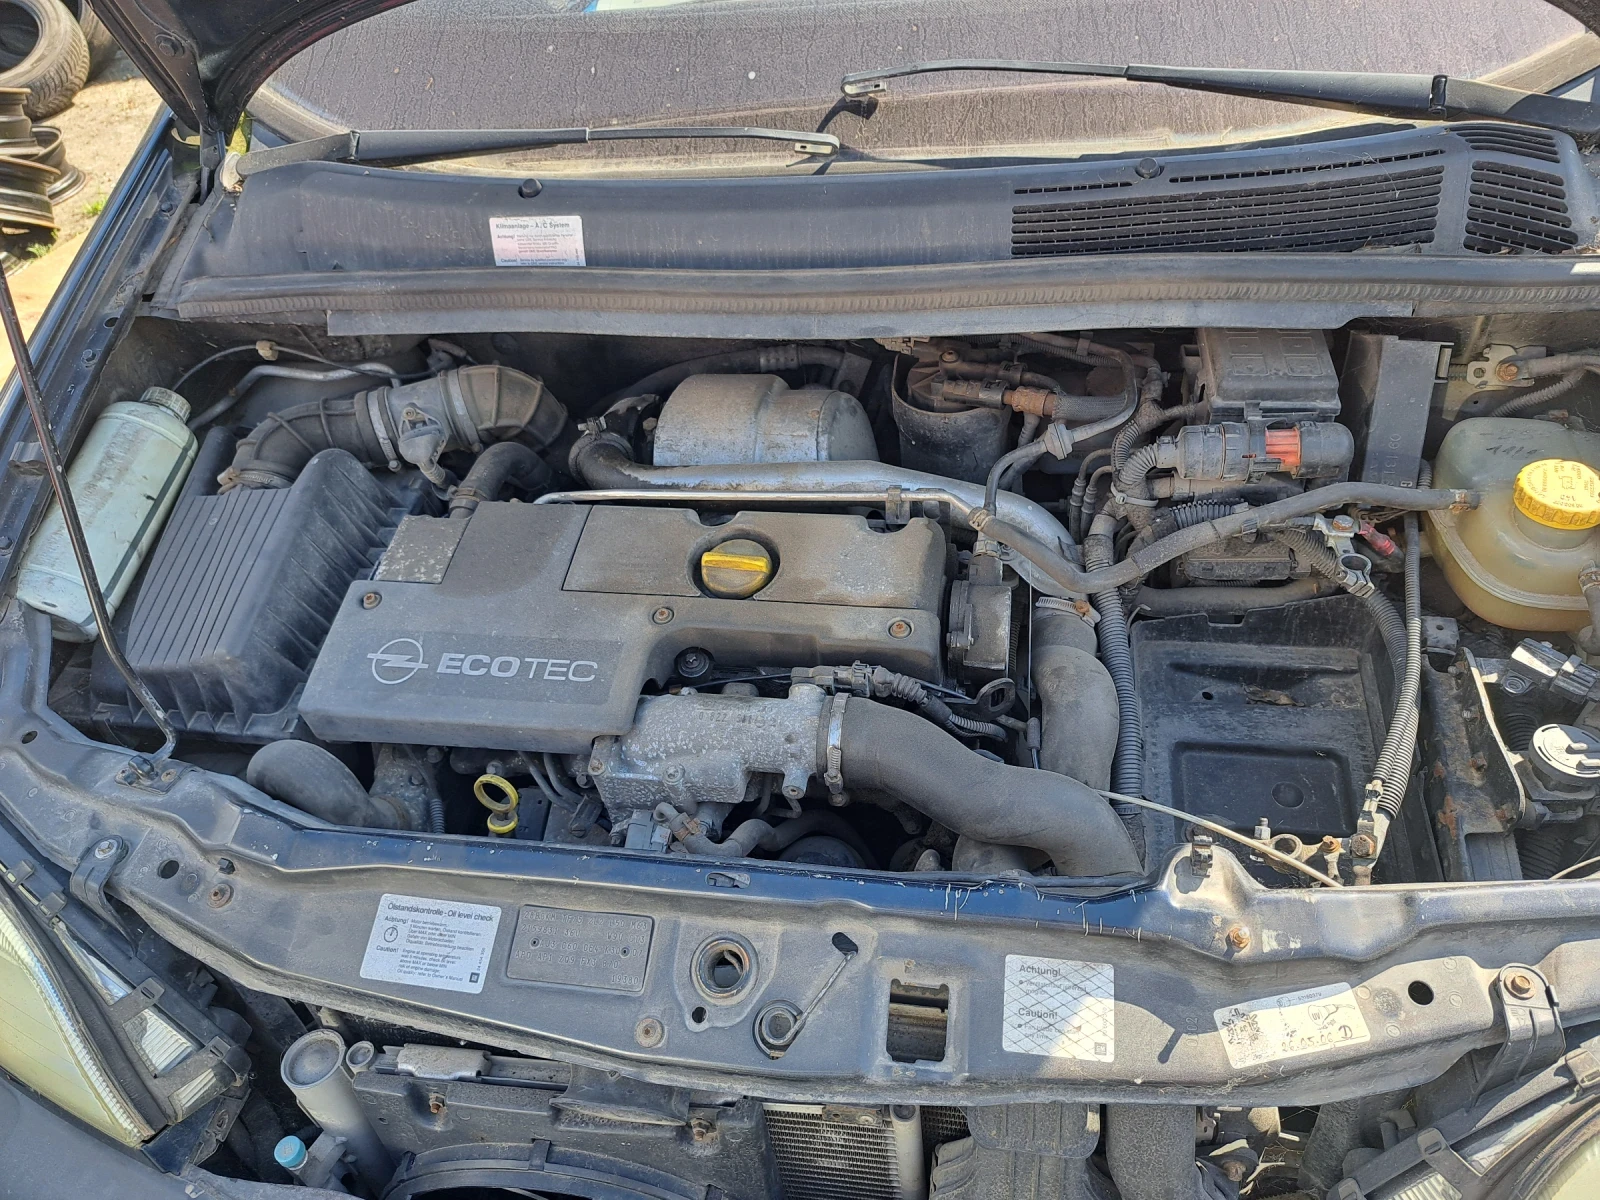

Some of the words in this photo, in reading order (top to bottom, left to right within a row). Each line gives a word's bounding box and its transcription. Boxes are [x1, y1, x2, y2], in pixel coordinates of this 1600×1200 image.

[436, 652, 598, 682] ECOTEC
[384, 915, 409, 924] Achtung!
[447, 910, 458, 918] Oil
[457, 911, 473, 919] level
[473, 914, 494, 922] check
[376, 945, 399, 953] Caution!
[1020, 965, 1061, 978] Achtung!
[1018, 1007, 1058, 1019] Caution!
